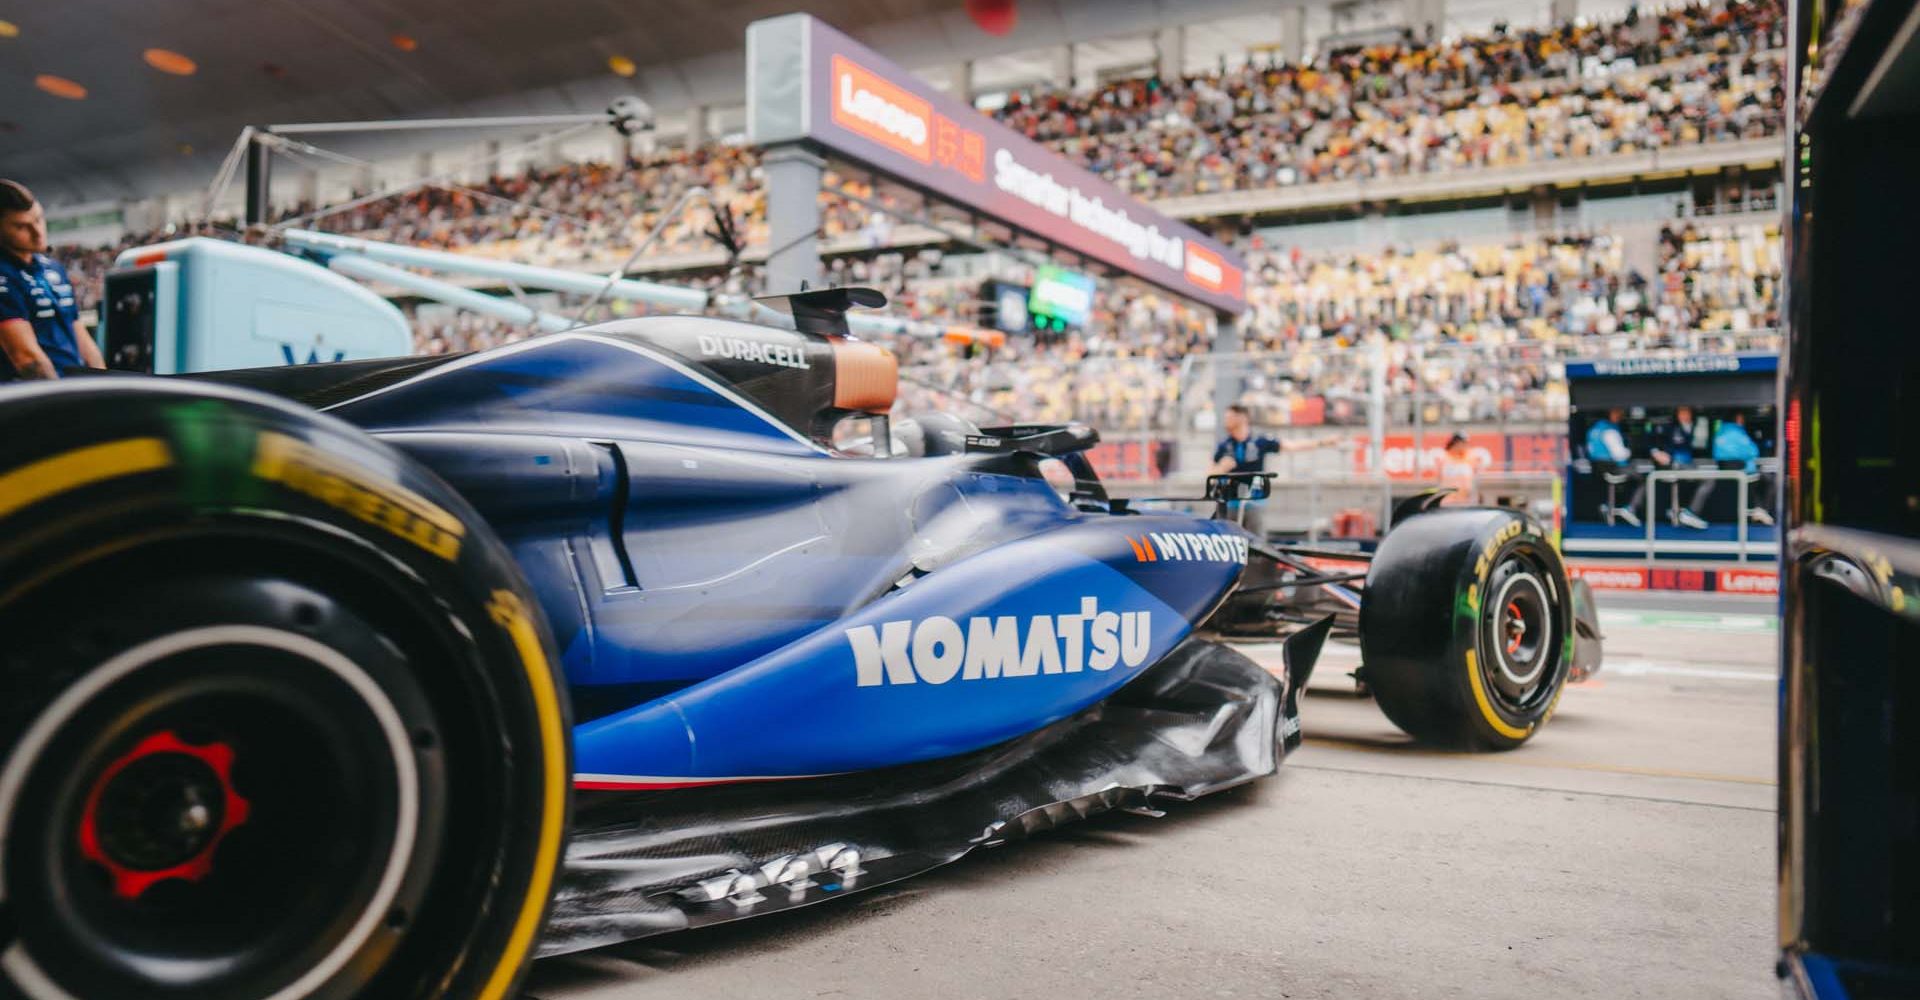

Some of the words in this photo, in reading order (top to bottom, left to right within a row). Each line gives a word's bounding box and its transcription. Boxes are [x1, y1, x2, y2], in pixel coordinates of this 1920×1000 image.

[698, 335, 811, 370] DURACELL
[1594, 357, 1674, 375] WILLIAMS
[1675, 354, 1740, 373] RACING
[846, 596, 1151, 687] KOMATSU
